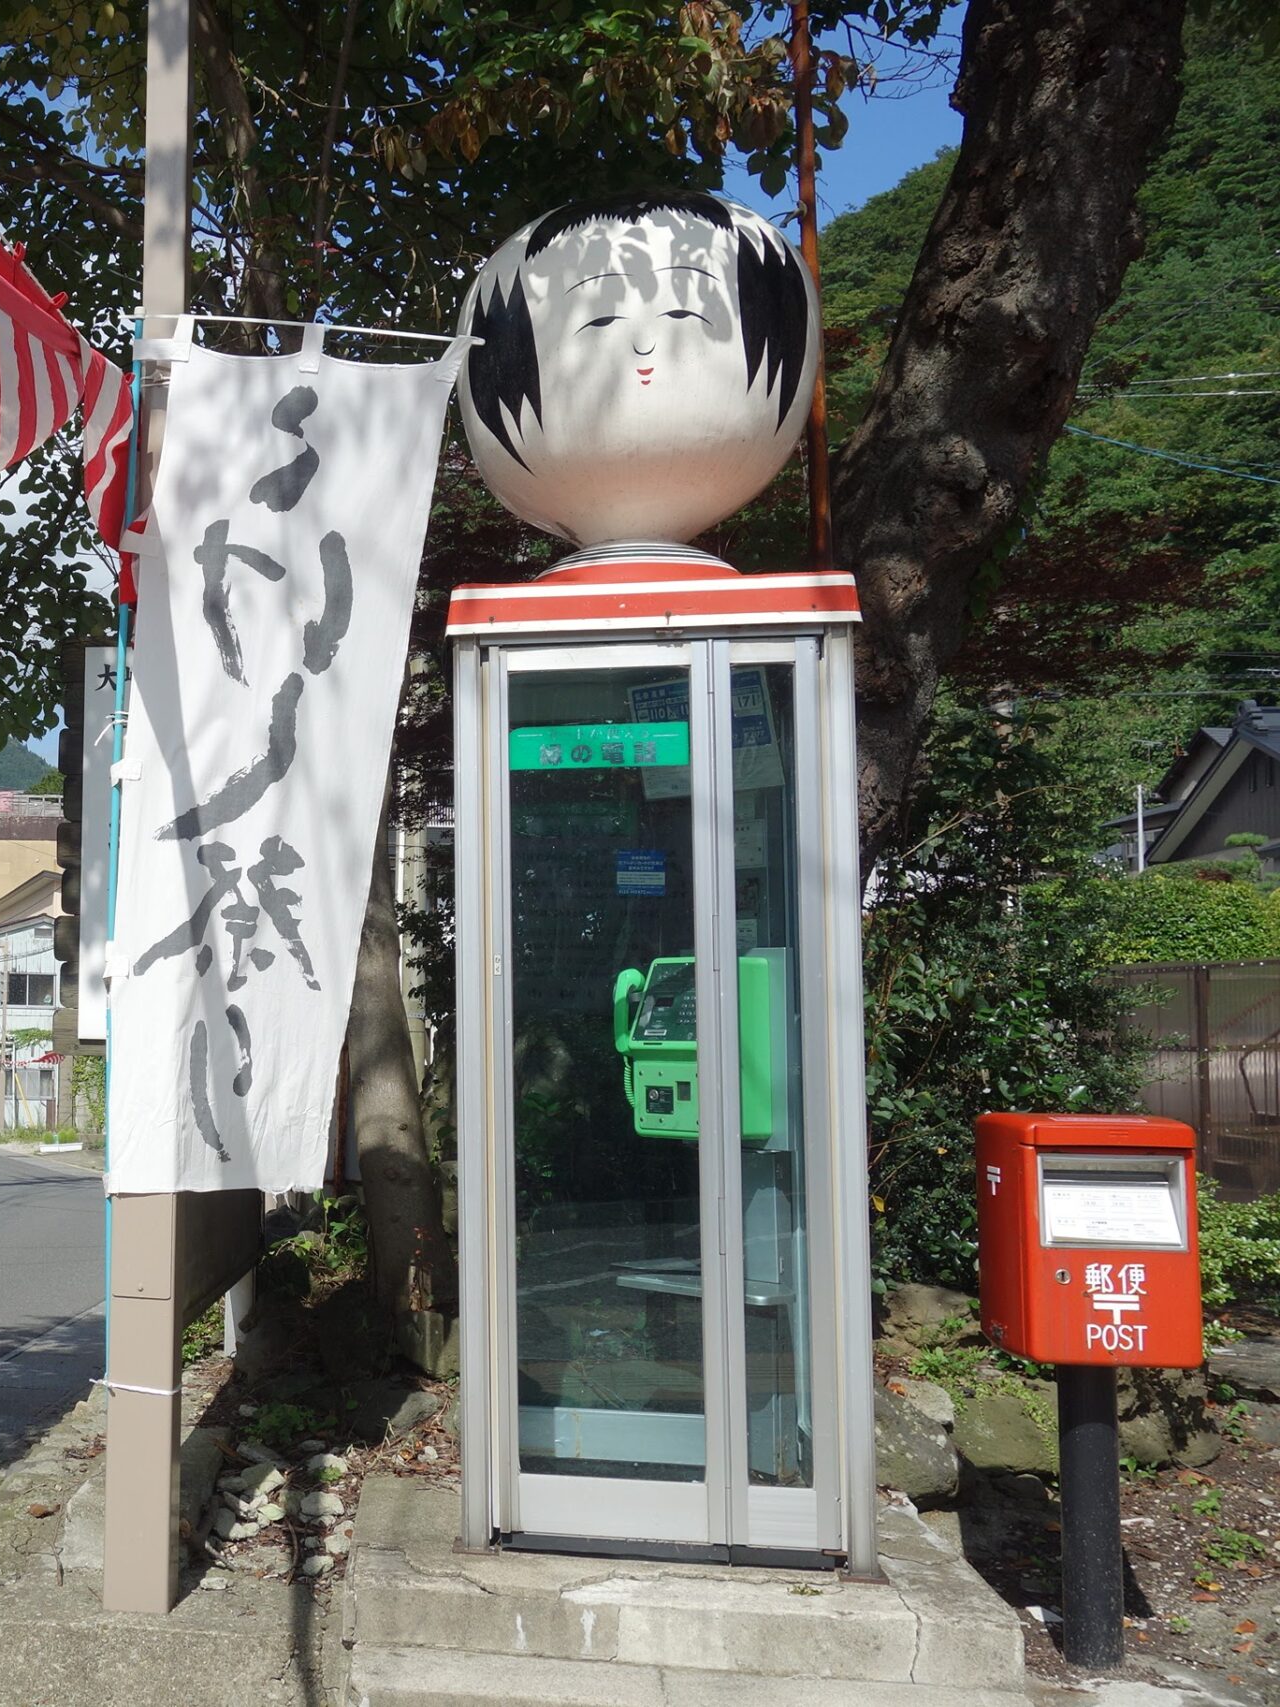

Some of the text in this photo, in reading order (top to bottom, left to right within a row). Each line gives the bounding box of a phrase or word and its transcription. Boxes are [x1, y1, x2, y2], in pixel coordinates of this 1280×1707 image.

[539, 741, 658, 766] 緑の電話
[1085, 1263, 1147, 1294] 郵便
[1086, 1324, 1148, 1352] POST
